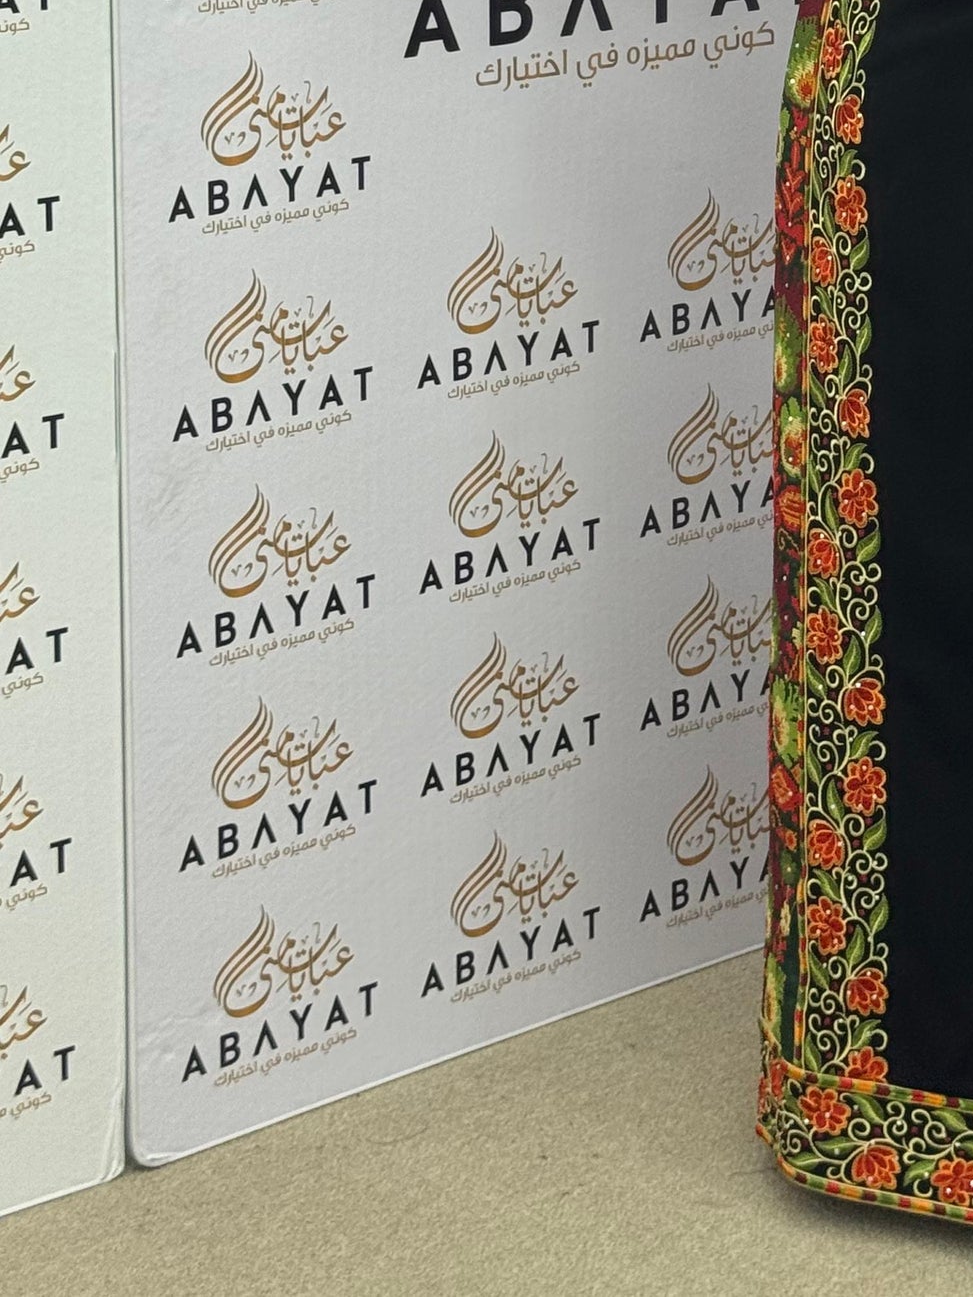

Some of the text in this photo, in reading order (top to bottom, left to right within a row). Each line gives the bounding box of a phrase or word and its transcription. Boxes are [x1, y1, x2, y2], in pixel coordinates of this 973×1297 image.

[474, 46, 569, 93] اختيارك
[575, 41, 619, 89] في
[701, 20, 775, 71] كوني
[168, 155, 371, 223] ABAYAT
[312, 197, 350, 223] كوني
[249, 210, 272, 234] في
[417, 319, 600, 390] ABAYAT
[172, 365, 373, 443] ABAYAT
[315, 408, 352, 435] كوني
[253, 425, 275, 449] في
[419, 517, 601, 595] ABAYAT
[176, 573, 376, 659] ABAYAT
[317, 617, 355, 645] كوني
[256, 637, 278, 661] في
[420, 712, 601, 798] ABAYAT
[179, 779, 377, 873] ABAYAT
[421, 906, 601, 998] ABAYAT
[181, 981, 378, 1083] ABAYAT
